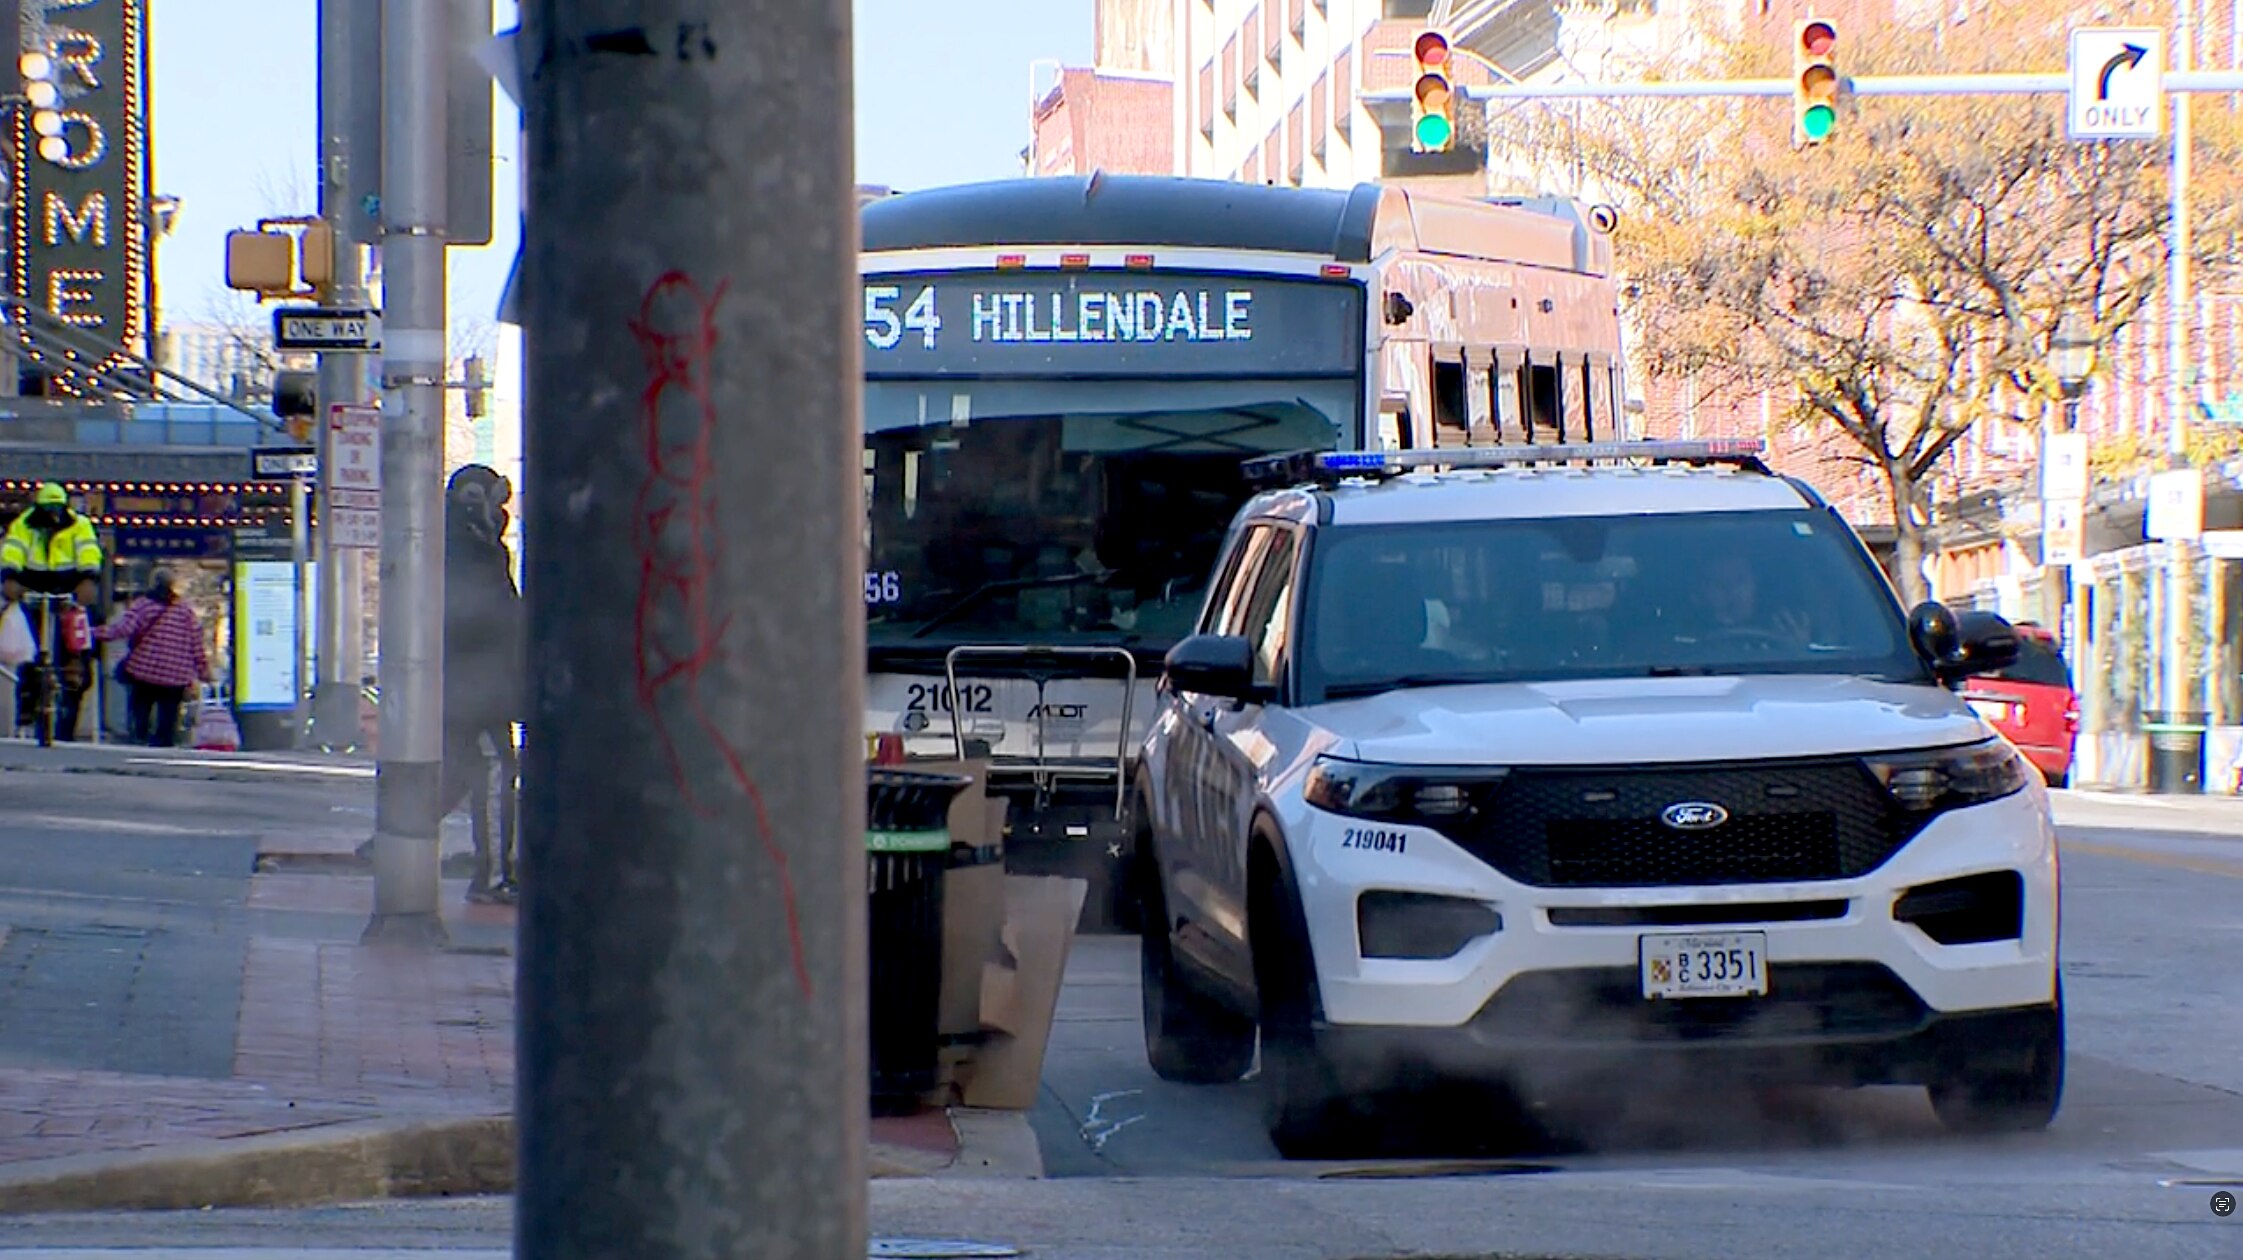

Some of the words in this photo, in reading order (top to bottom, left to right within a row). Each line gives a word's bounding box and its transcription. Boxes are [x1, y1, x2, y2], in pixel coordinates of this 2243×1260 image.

[2086, 106, 2150, 126] ONLY
[289, 320, 324, 337] ONE
[332, 320, 366, 337] WAY
[864, 285, 942, 350] 54
[972, 291, 1253, 342] HILLENDALE
[864, 571, 900, 603] 56
[907, 684, 993, 712] 21012
[1342, 828, 1407, 853] 219041
[1697, 951, 1757, 980] 3351
